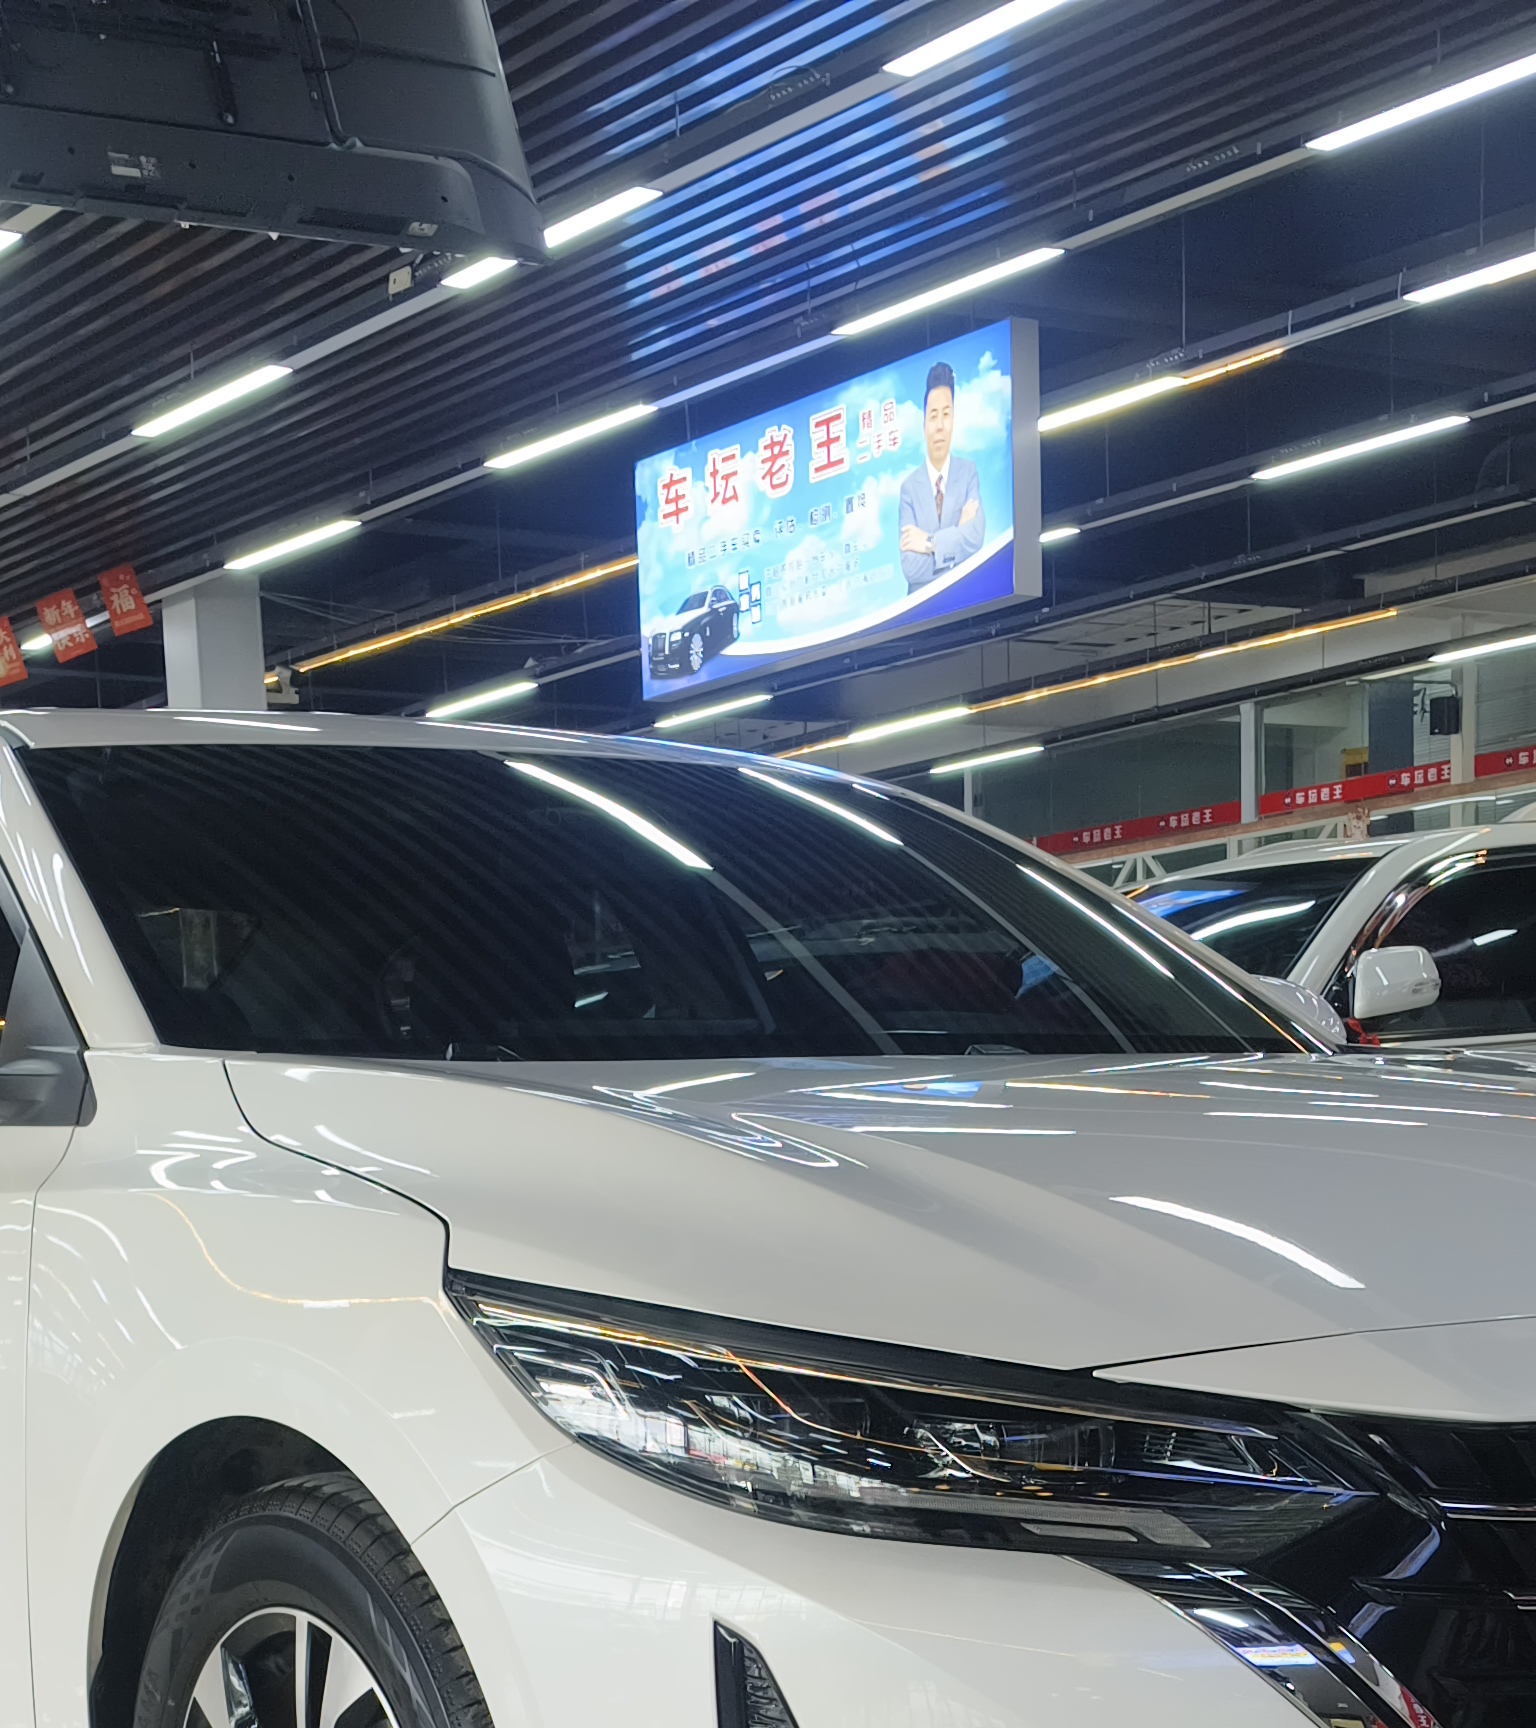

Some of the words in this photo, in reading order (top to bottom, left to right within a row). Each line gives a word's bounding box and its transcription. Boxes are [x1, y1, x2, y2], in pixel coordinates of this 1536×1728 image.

[661, 411, 846, 526] 车坛老王
[43, 599, 80, 626] 新年
[109, 583, 137, 616] 福
